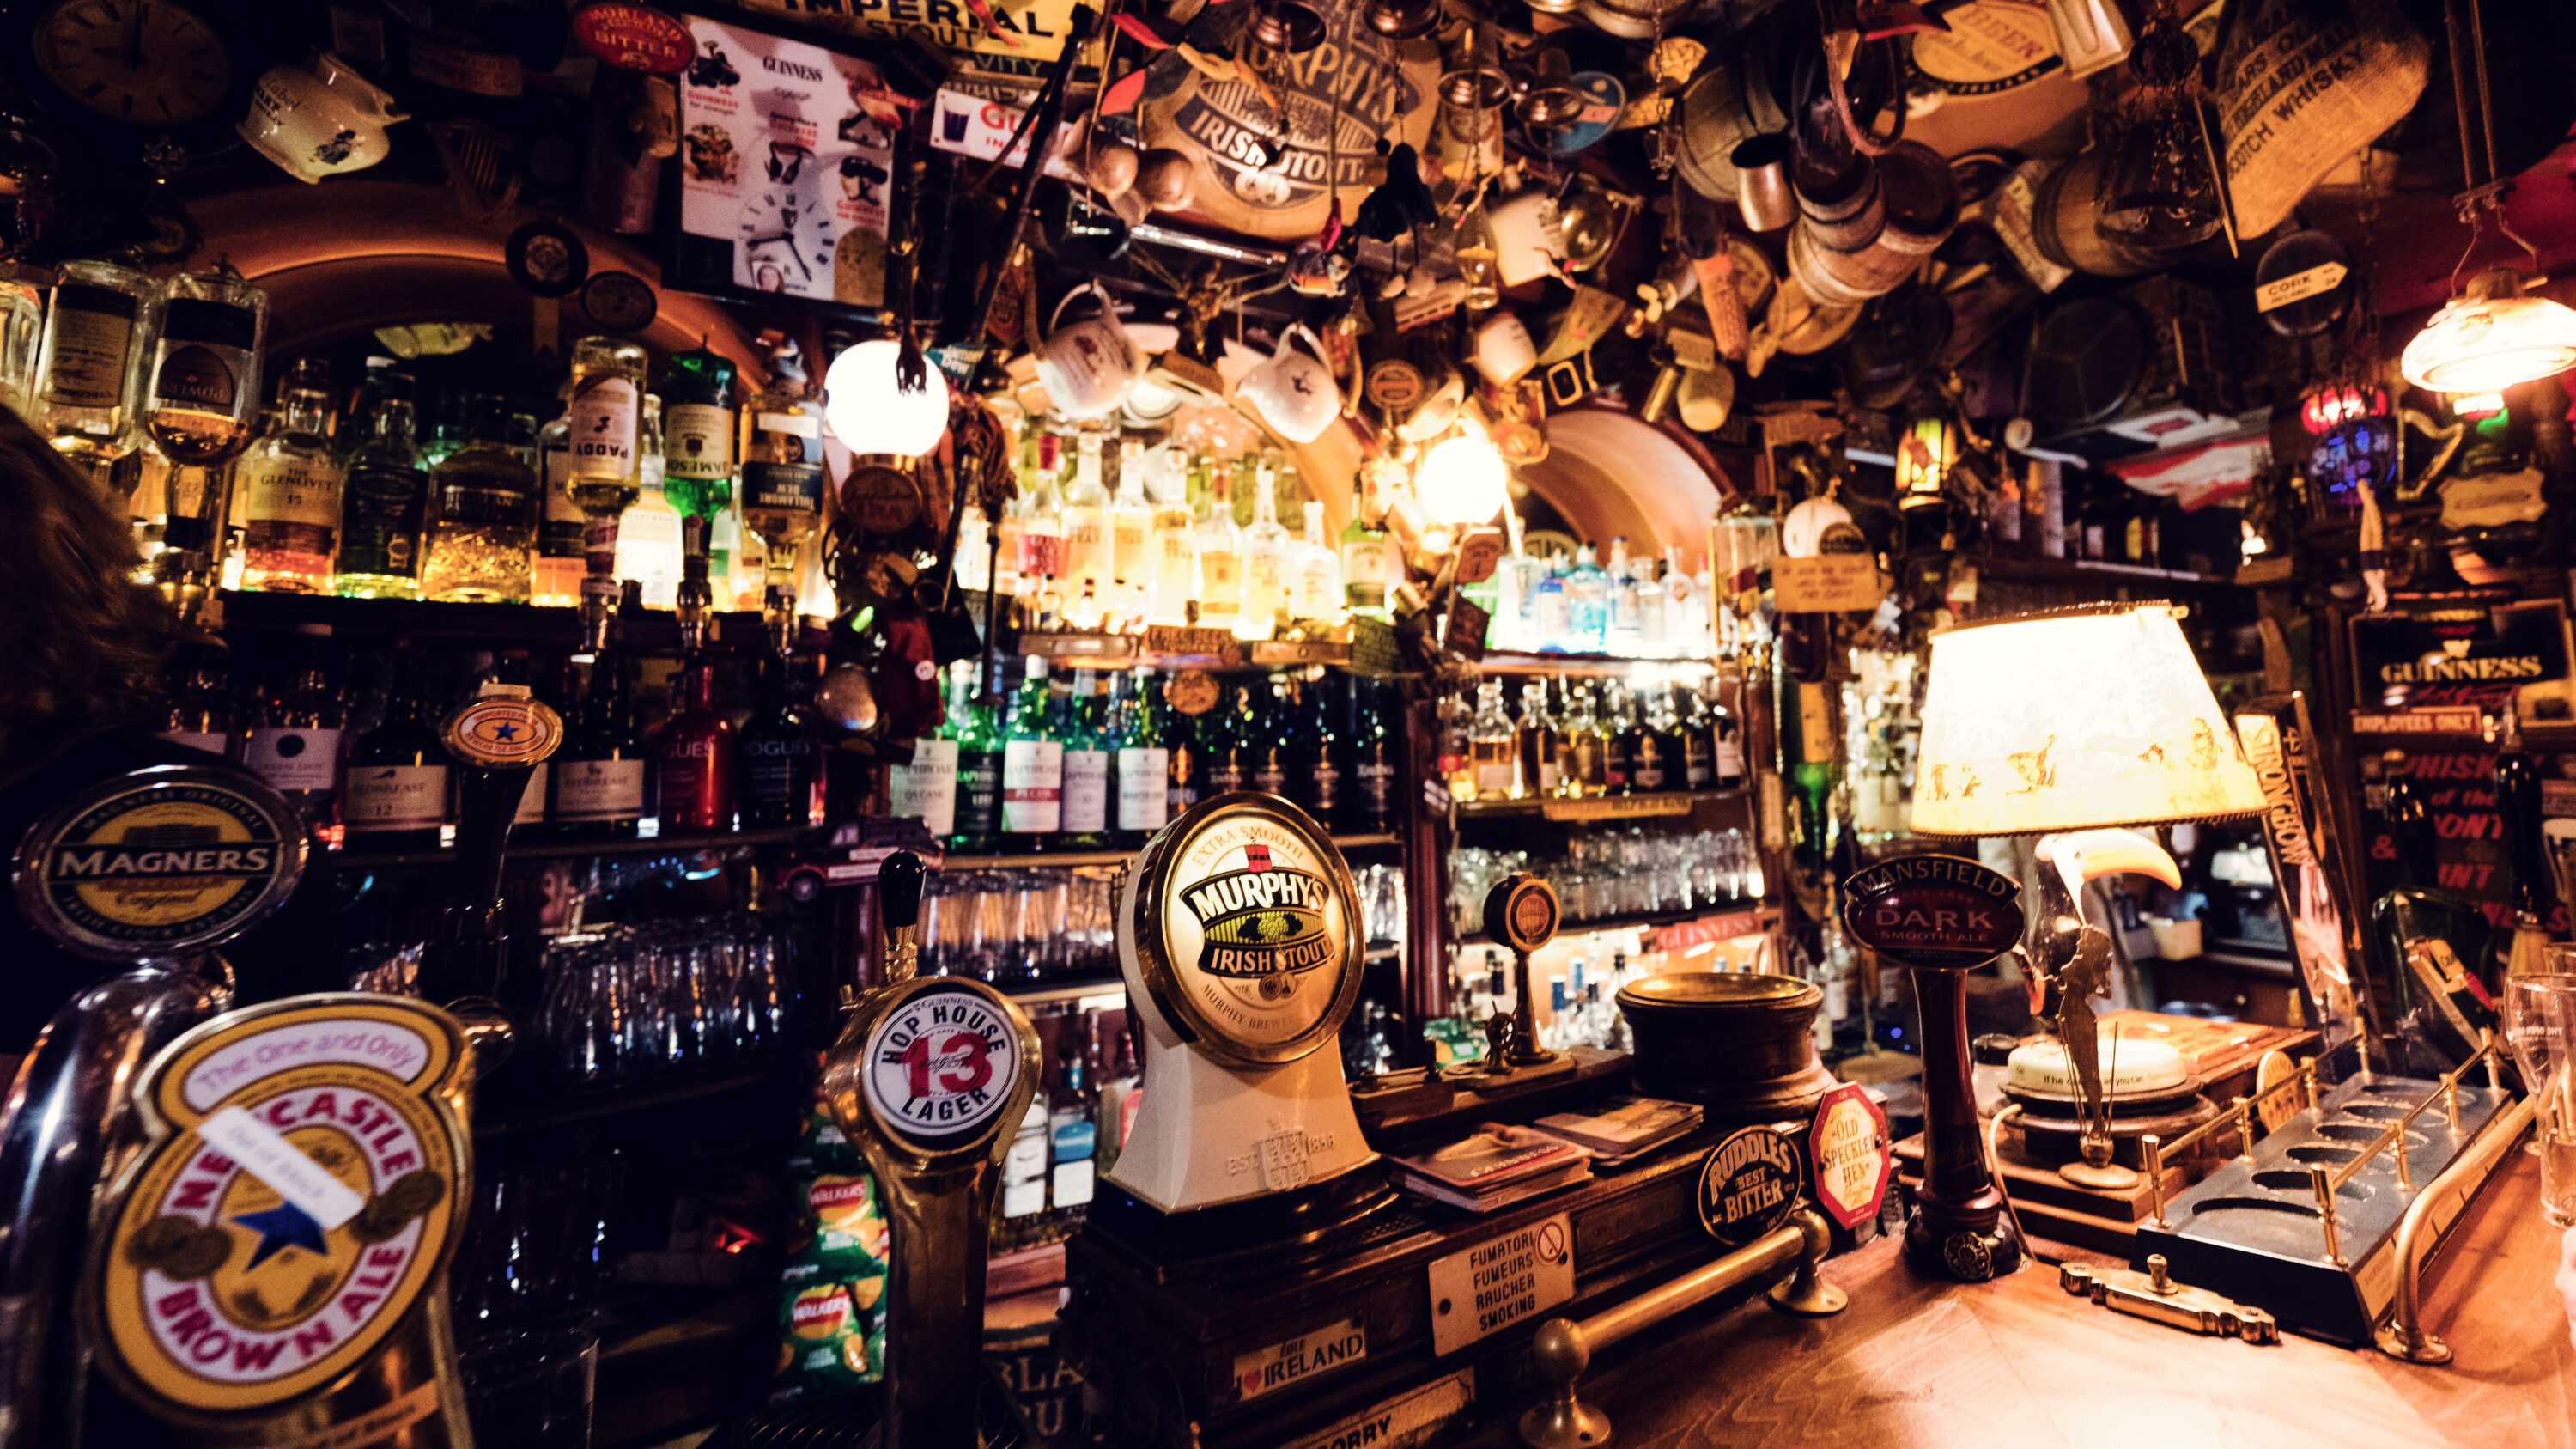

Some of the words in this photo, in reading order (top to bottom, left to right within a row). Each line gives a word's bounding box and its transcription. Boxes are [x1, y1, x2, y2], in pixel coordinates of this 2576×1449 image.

[595, 30, 677, 58] BITTER
[762, 55, 823, 82] GUINNESS
[2272, 40, 2365, 122] WHISKY
[2269, 274, 2312, 295] CORK
[576, 441, 629, 460] PADDY
[260, 474, 333, 492] GLENLIVET
[2380, 654, 2543, 684] GUINNESS
[2353, 715, 2433, 734] EMPLOYEES
[2435, 715, 2476, 732] ONLY
[56, 847, 271, 877] MAGNERS
[1192, 829, 1237, 868] EXTRA
[1240, 825, 1305, 860] SMOOTH
[1189, 872, 1325, 922] MURPHY'S
[1856, 859, 2008, 898] MANSFIELD
[1659, 918, 1754, 950] GUINNESS
[1875, 908, 1995, 930] DARK
[1880, 929, 1950, 941] SMOOTH
[1955, 931, 1990, 942] ALE
[1210, 947, 1271, 974] IRISH
[1274, 940, 1329, 971] STOUT
[1200, 983, 1247, 1028] MURPHY
[881, 1016, 920, 1065] HOP
[932, 1005, 1006, 1055] HOUSE
[197, 1056, 250, 1089] The
[254, 1038, 309, 1064] One
[313, 1033, 362, 1051] and
[366, 1033, 420, 1069] Only
[894, 1032, 993, 1098] 13
[901, 1086, 990, 1121] LAGER
[173, 1092, 416, 1209] NECASTLE
[1708, 1132, 1792, 1207] RUDDLES
[1735, 1167, 1766, 1191] BEST
[1724, 1178, 1785, 1224] BITTER
[1469, 1230, 1534, 1269] FUMATORI
[1473, 1252, 1534, 1290] FUMEURS
[156, 1287, 335, 1372] BROWN
[341, 1245, 406, 1323] ALE
[1475, 1274, 1535, 1312] RAUCHER
[1479, 1294, 1536, 1332] SMOKING
[1263, 1333, 1364, 1388] IRELAND
